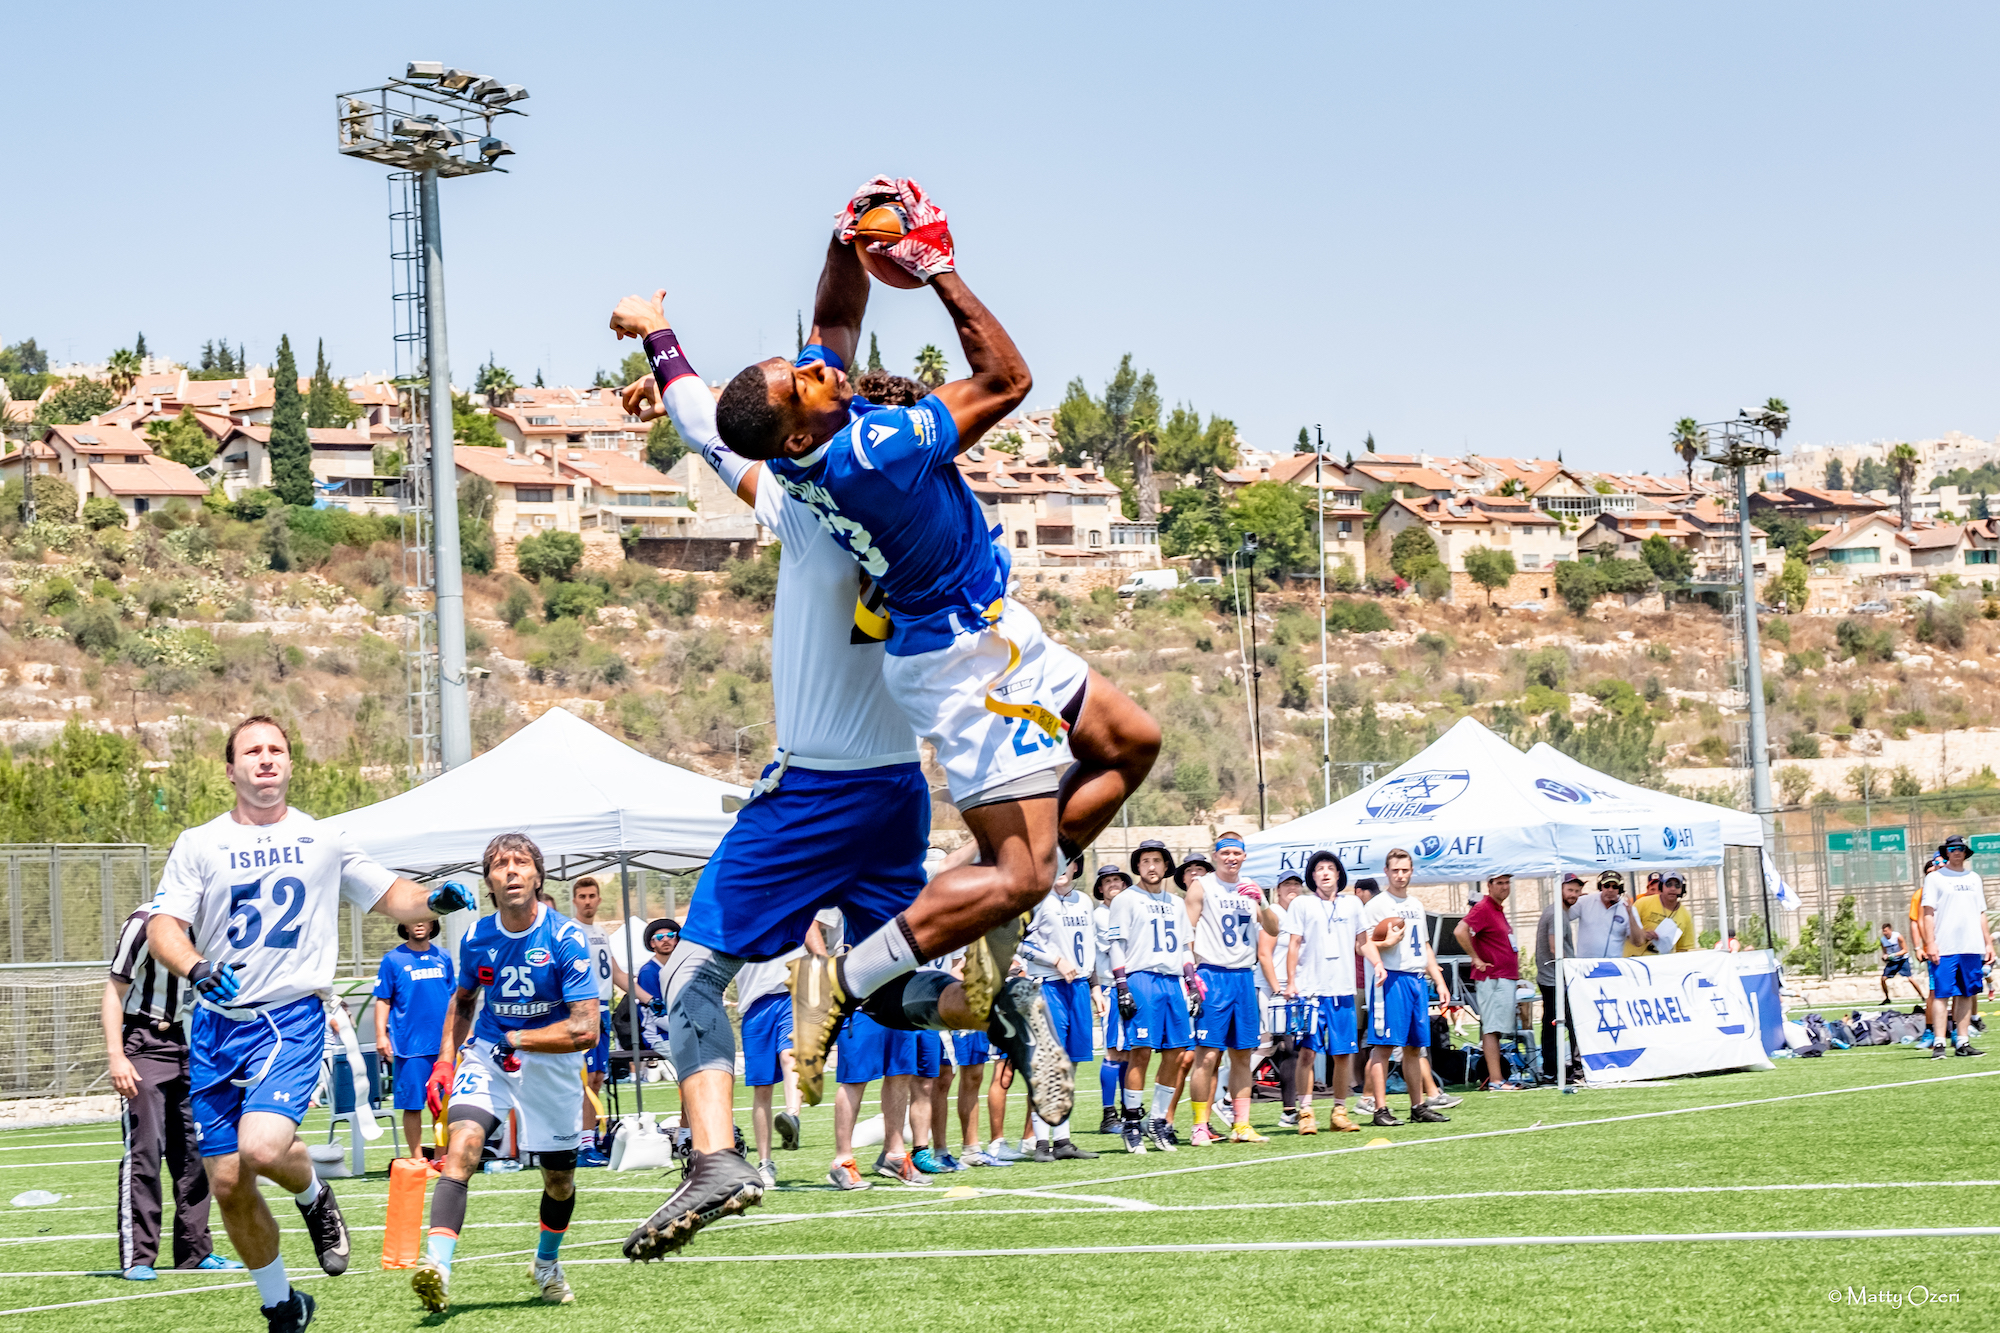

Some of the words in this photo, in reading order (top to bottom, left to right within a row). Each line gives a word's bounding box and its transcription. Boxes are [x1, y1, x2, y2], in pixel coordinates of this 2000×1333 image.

[1447, 836, 1484, 855] AFI
[1593, 834, 1641, 855] KRAFT
[1678, 828, 1694, 847] AFI
[230, 846, 304, 869] ISRAEL
[1279, 845, 1369, 870] KRFT
[227, 876, 306, 950] 52
[1220, 900, 1251, 910] ISRAEL
[1062, 916, 1089, 927] ISRAEL
[1221, 914, 1251, 947] 87
[1151, 918, 1177, 953] 15
[1410, 925, 1421, 957] 4
[1074, 931, 1084, 967] 6
[410, 967, 444, 981] ISRAEL
[599, 949, 611, 979] 8
[501, 966, 536, 997] 25
[492, 1002, 550, 1016] ITALIA
[1626, 997, 1691, 1027] ISRAEL
